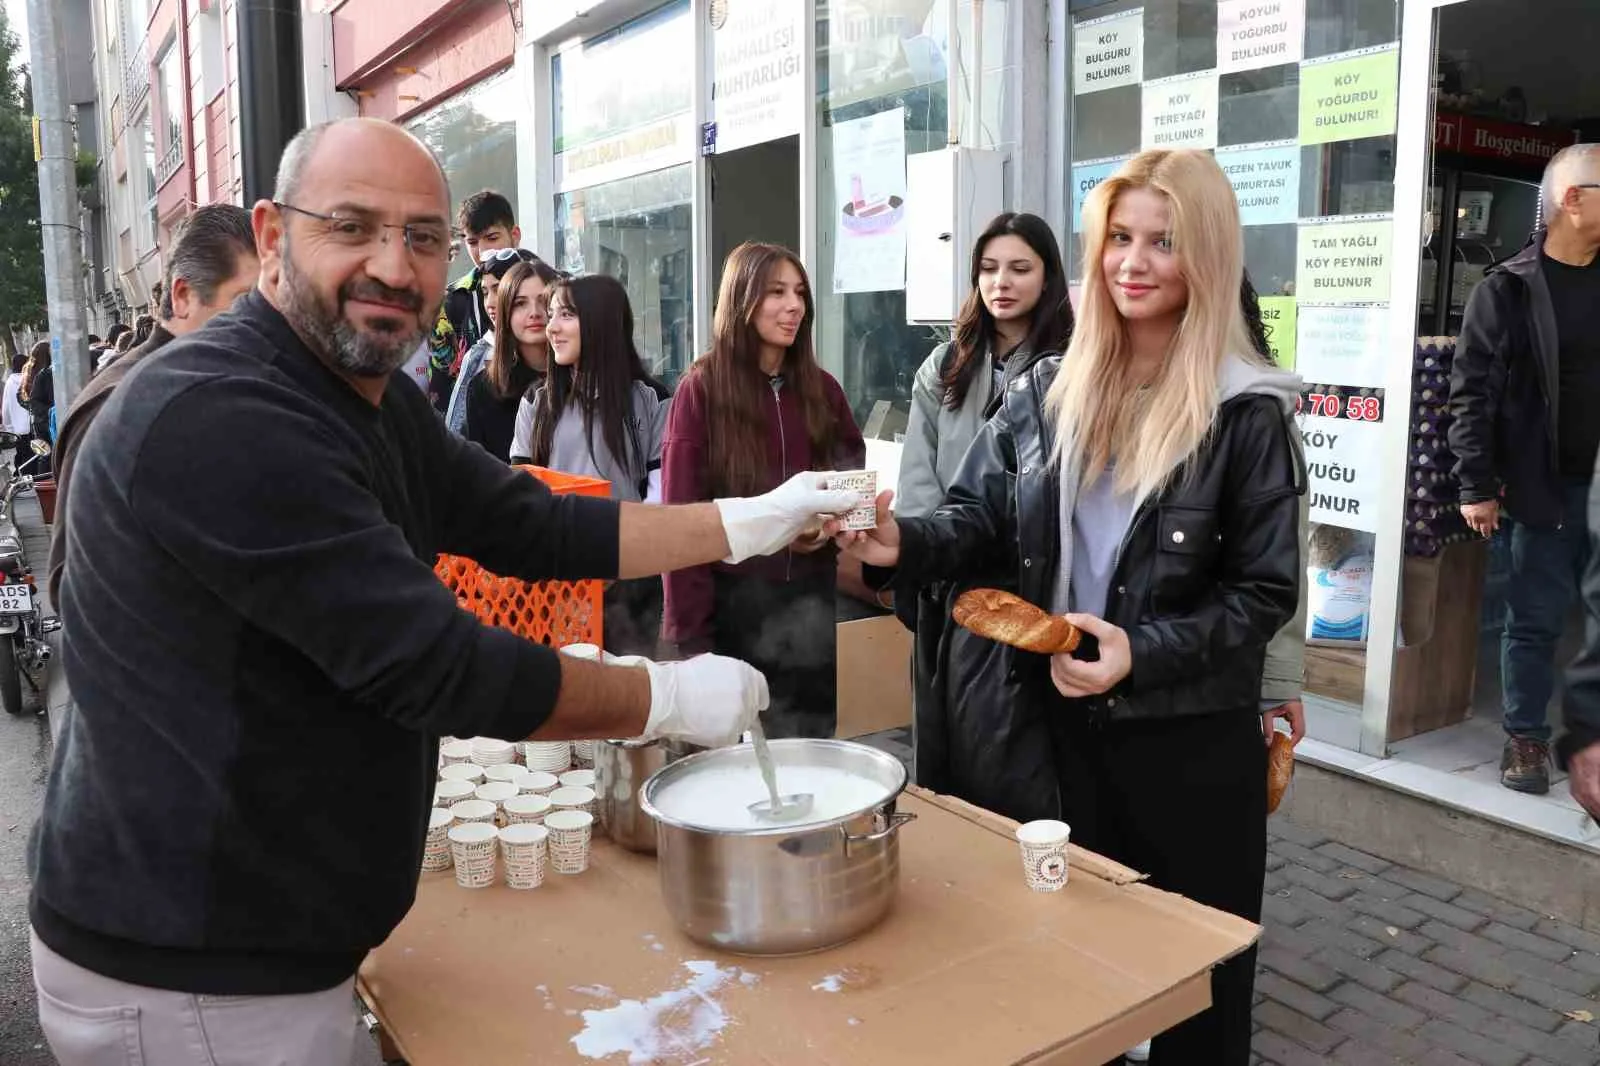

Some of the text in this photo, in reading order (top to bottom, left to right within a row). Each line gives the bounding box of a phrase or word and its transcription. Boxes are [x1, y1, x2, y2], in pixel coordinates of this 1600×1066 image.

[1086, 47, 1131, 65] BULGURU
[1231, 42, 1287, 61] BULUNUR
[715, 53, 801, 99] MUHTARLIĞI
[1086, 64, 1131, 82] BULUNUR
[1154, 127, 1205, 144] BULUNUR
[1257, 159, 1292, 172] TAVUK
[1232, 178, 1286, 191] UMURTASI
[1238, 196, 1280, 208] ULUNUR
[1312, 235, 1377, 249] TAM YAĞLI
[1305, 254, 1383, 269] KÖY PEYNİRİ
[1313, 277, 1372, 288] BULUNUR
[1263, 306, 1281, 320] SİZ
[1308, 393, 1340, 418] 70
[1346, 395, 1380, 421] 58
[1300, 429, 1339, 450] KÖY
[0, 599, 20, 610] 82
